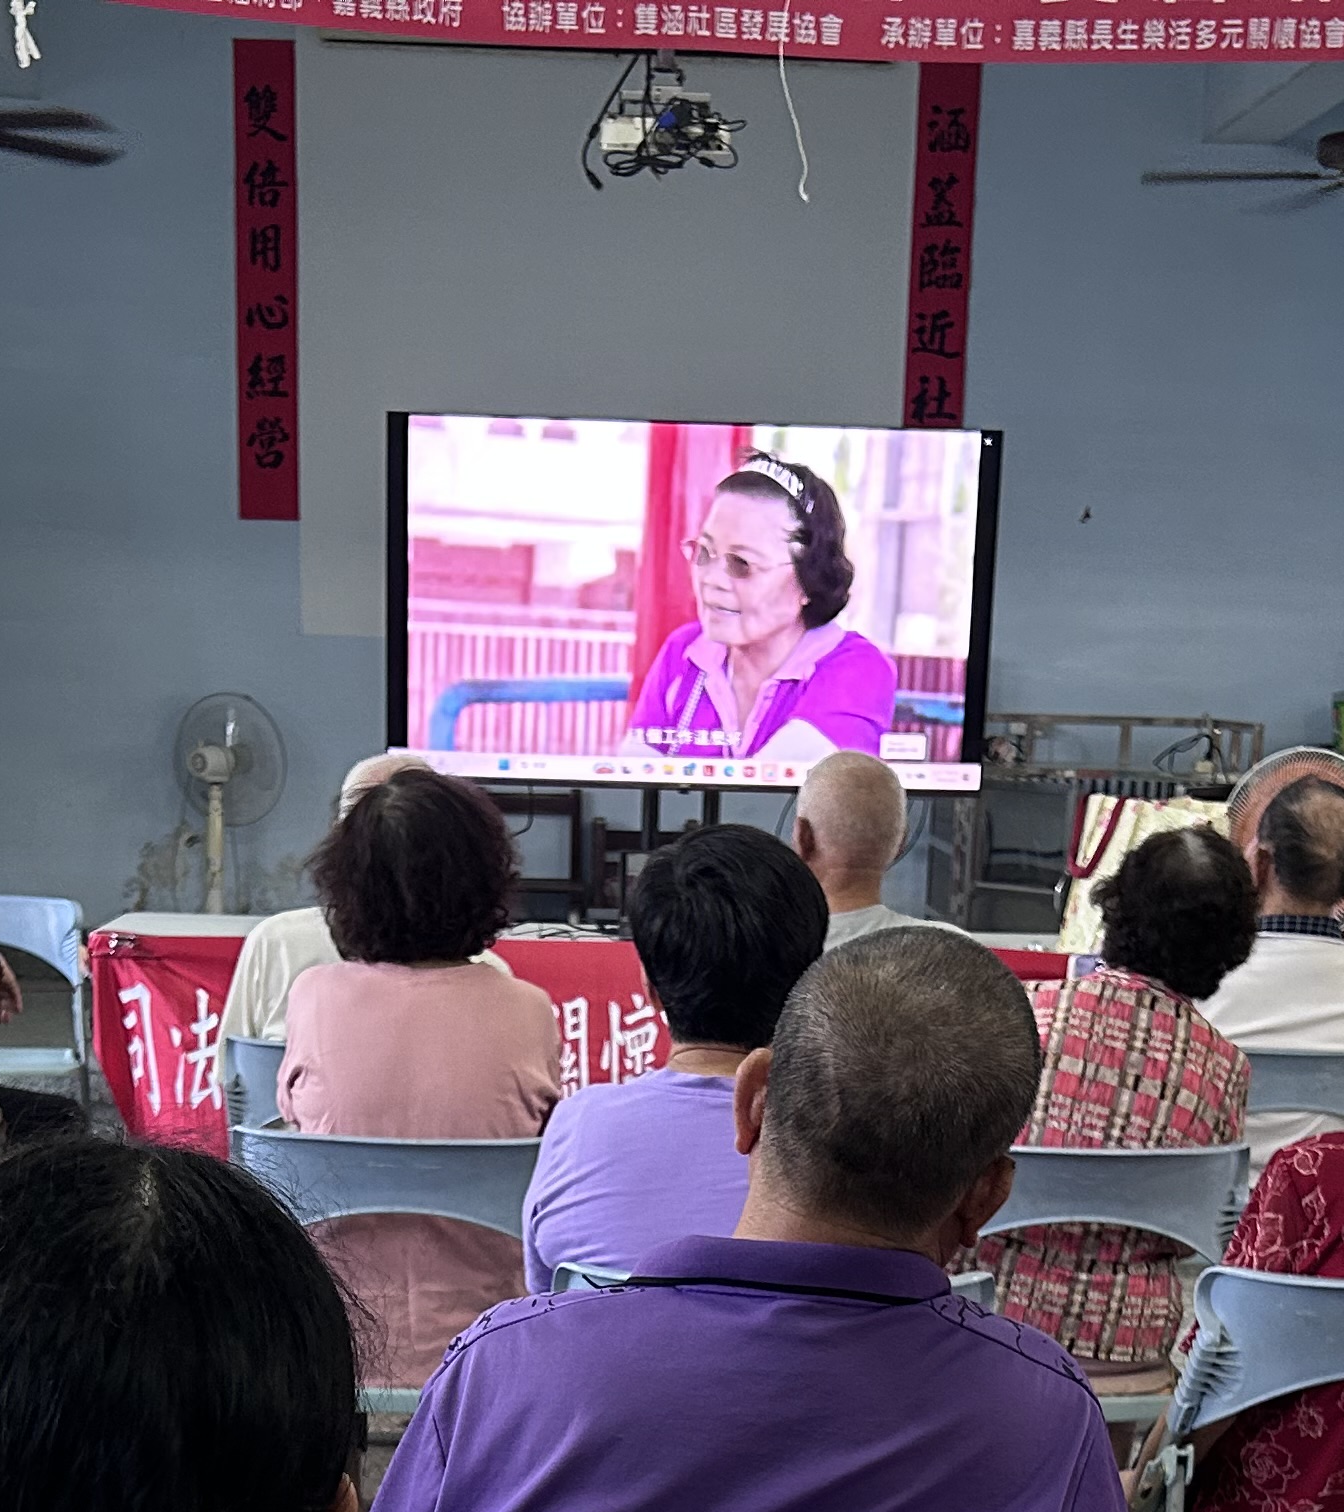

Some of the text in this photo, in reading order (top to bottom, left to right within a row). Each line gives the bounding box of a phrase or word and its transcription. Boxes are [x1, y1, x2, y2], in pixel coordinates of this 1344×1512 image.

[243, 84, 290, 470] 雙倍用心經營
[119, 984, 222, 1115] 司法
